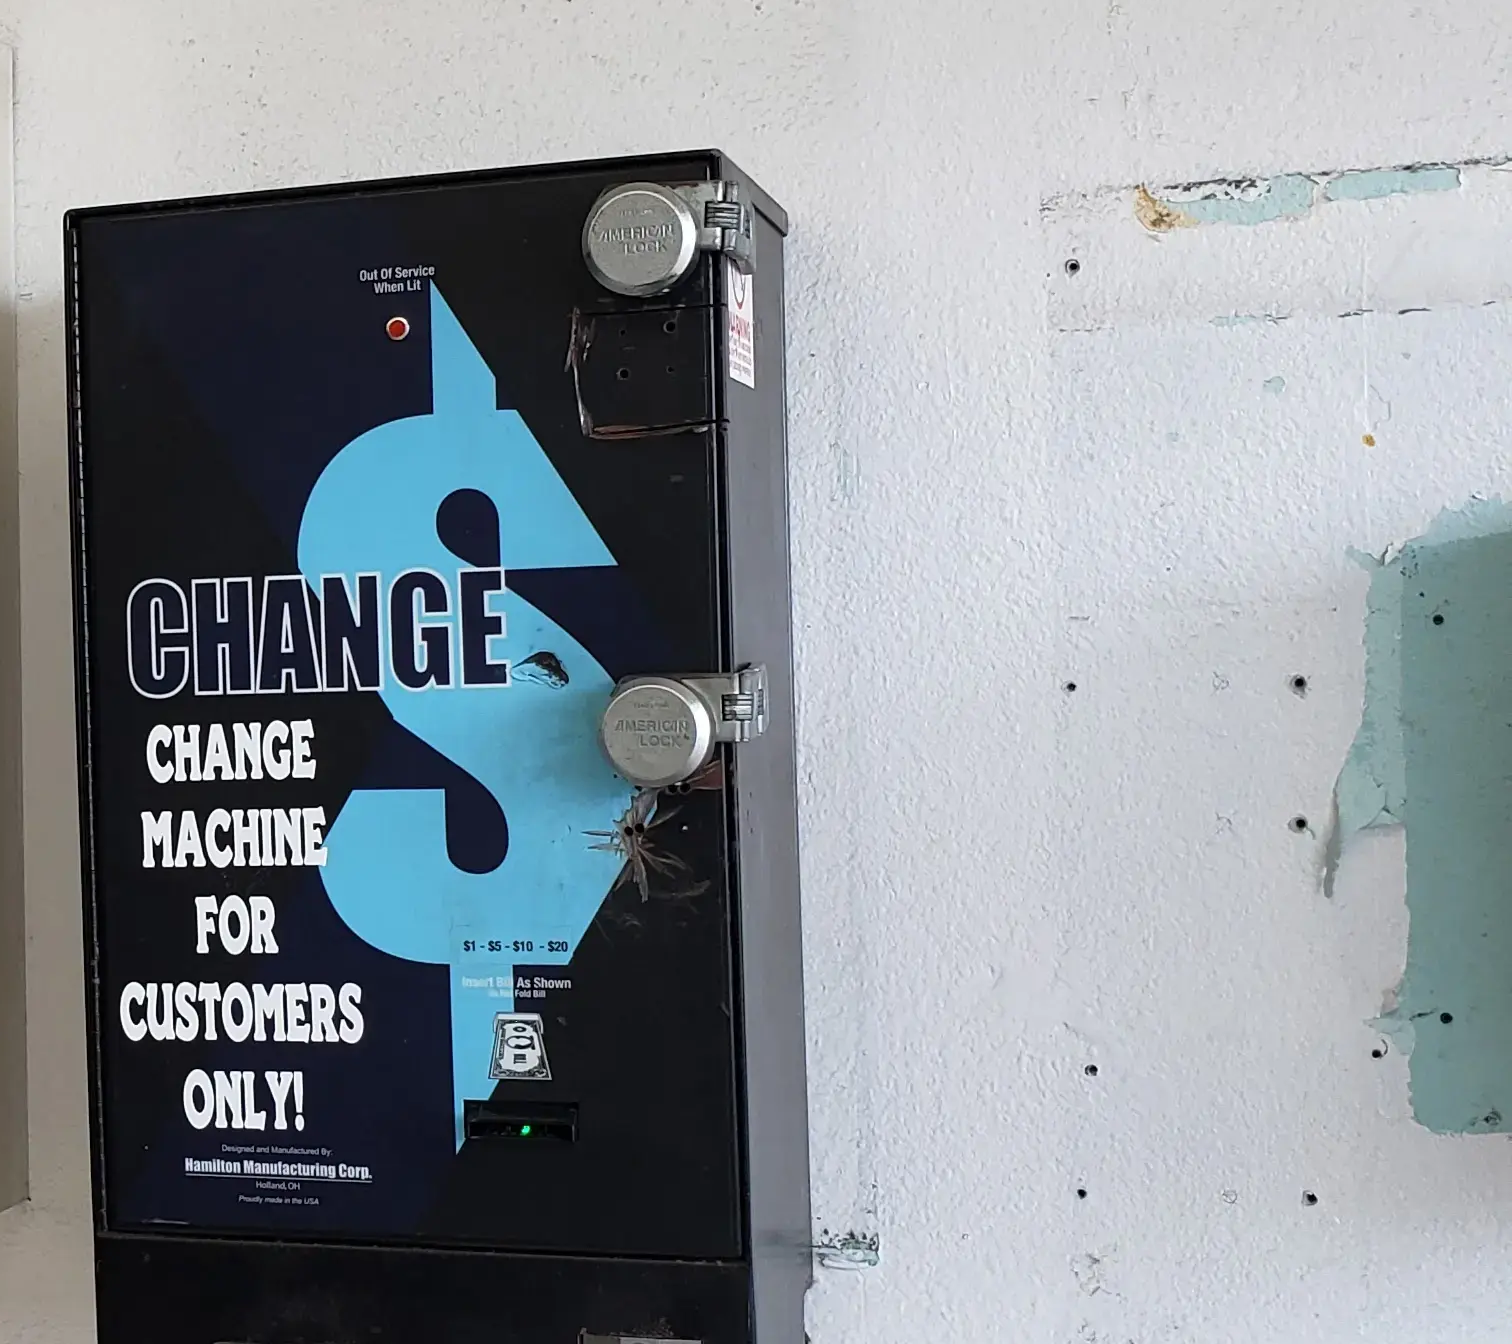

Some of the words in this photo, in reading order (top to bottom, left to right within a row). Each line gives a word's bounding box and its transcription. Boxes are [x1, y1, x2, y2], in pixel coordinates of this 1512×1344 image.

[624, 240, 668, 256] LOCK
[359, 269, 378, 281] Out
[380, 267, 392, 279] Of
[394, 265, 435, 278] Service
[374, 281, 404, 294] When
[406, 279, 421, 291] Lit
[126, 567, 512, 699] CHANGE
[614, 719, 689, 733] AMERICAN
[639, 735, 681, 749] LOCK
[146, 718, 316, 783] CHANGE
[141, 805, 327, 868] MACHINE
[194, 894, 279, 955] FOR
[463, 940, 476, 952] $1
[488, 940, 502, 952] $5
[513, 940, 533, 952] $10
[548, 940, 568, 952] $20
[517, 976, 531, 989] As
[533, 976, 572, 989] Shown
[515, 989, 532, 998] Fold
[533, 989, 546, 998] Bill
[119, 981, 365, 1044] CUSTOMERS
[183, 1068, 305, 1131] ONLY!
[221, 1144, 254, 1154] Designed
[271, 1146, 319, 1155] Manufactured
[185, 1157, 241, 1173] Hamilton
[243, 1159, 337, 1179] Manufacturing
[338, 1163, 373, 1179] Corp.
[255, 1181, 287, 1190] Holland,
[288, 1182, 301, 1190] OH
[238, 1195, 263, 1204] Proudly
[264, 1196, 283, 1204] made
[284, 1196, 291, 1204] in
[303, 1197, 319, 1205] USA
